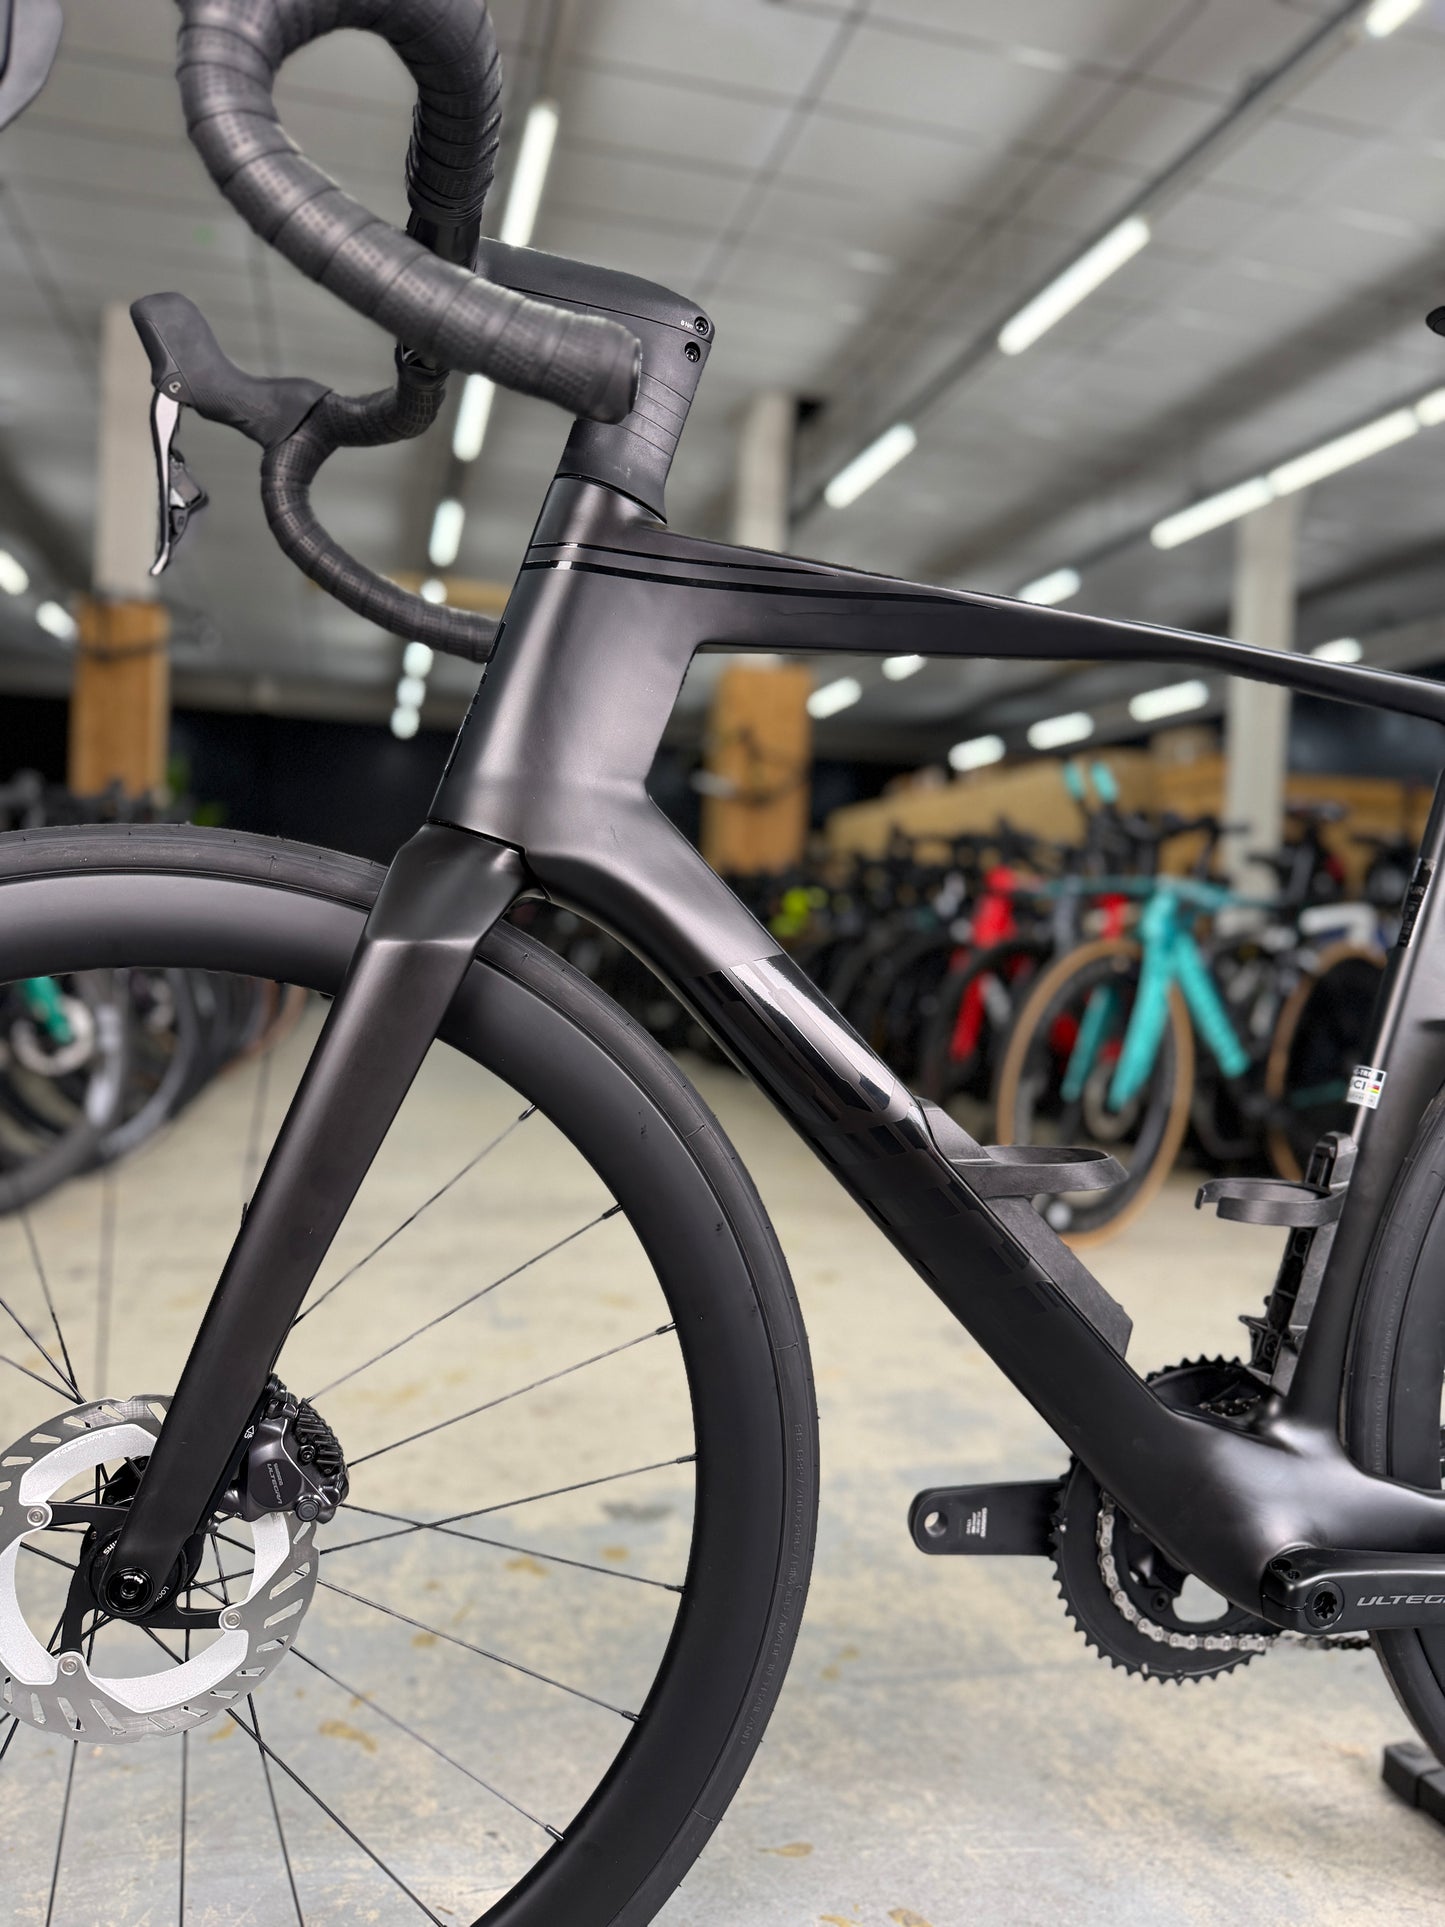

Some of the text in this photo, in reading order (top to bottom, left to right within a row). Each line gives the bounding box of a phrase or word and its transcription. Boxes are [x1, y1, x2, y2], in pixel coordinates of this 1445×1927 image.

[1351, 1079, 1366, 1090] CI
[266, 1463, 283, 1505] ULTEGRA
[1356, 1594, 1445, 1607] ULTEG
